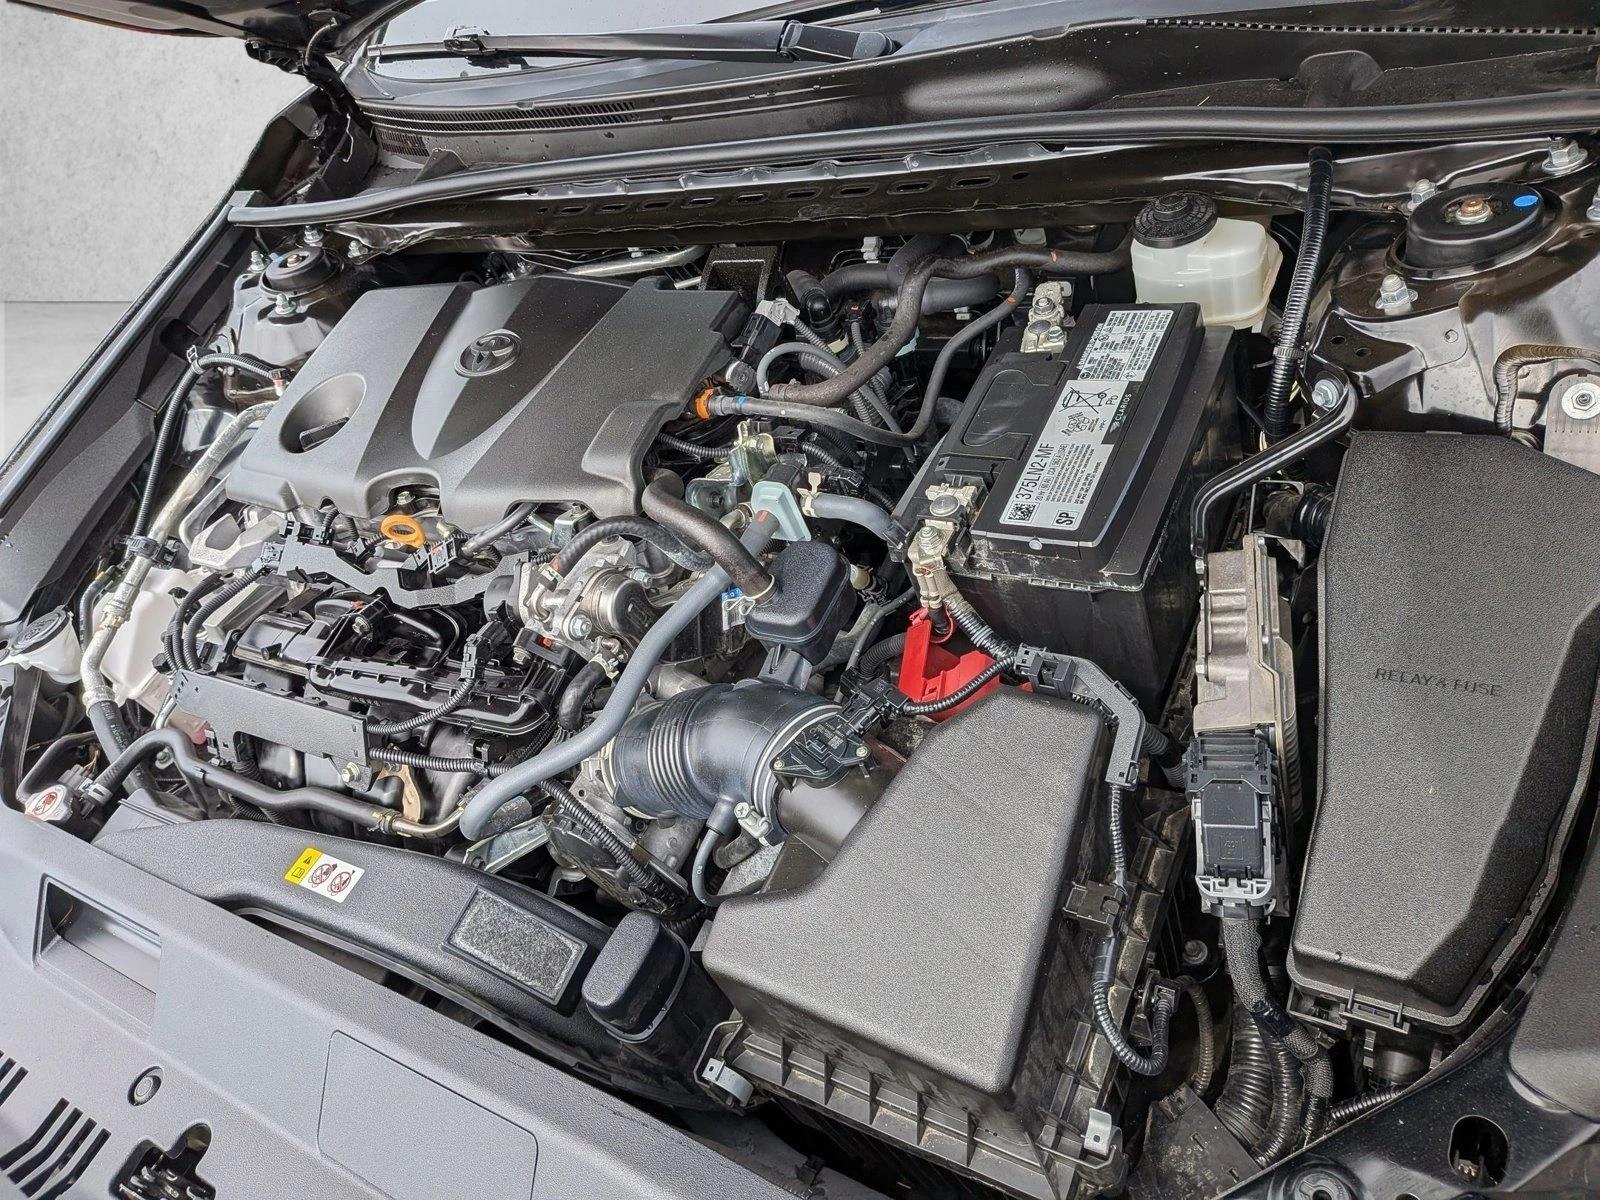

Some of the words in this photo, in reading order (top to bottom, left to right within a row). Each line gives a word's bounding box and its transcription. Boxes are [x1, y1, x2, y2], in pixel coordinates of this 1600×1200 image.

[1116, 394, 1131, 420] CLARIOS
[1015, 443, 1054, 499] 375LN2-MF
[1056, 512, 1075, 525] SP
[1375, 667, 1433, 686] RELAY
[1453, 679, 1503, 696] FUSE
